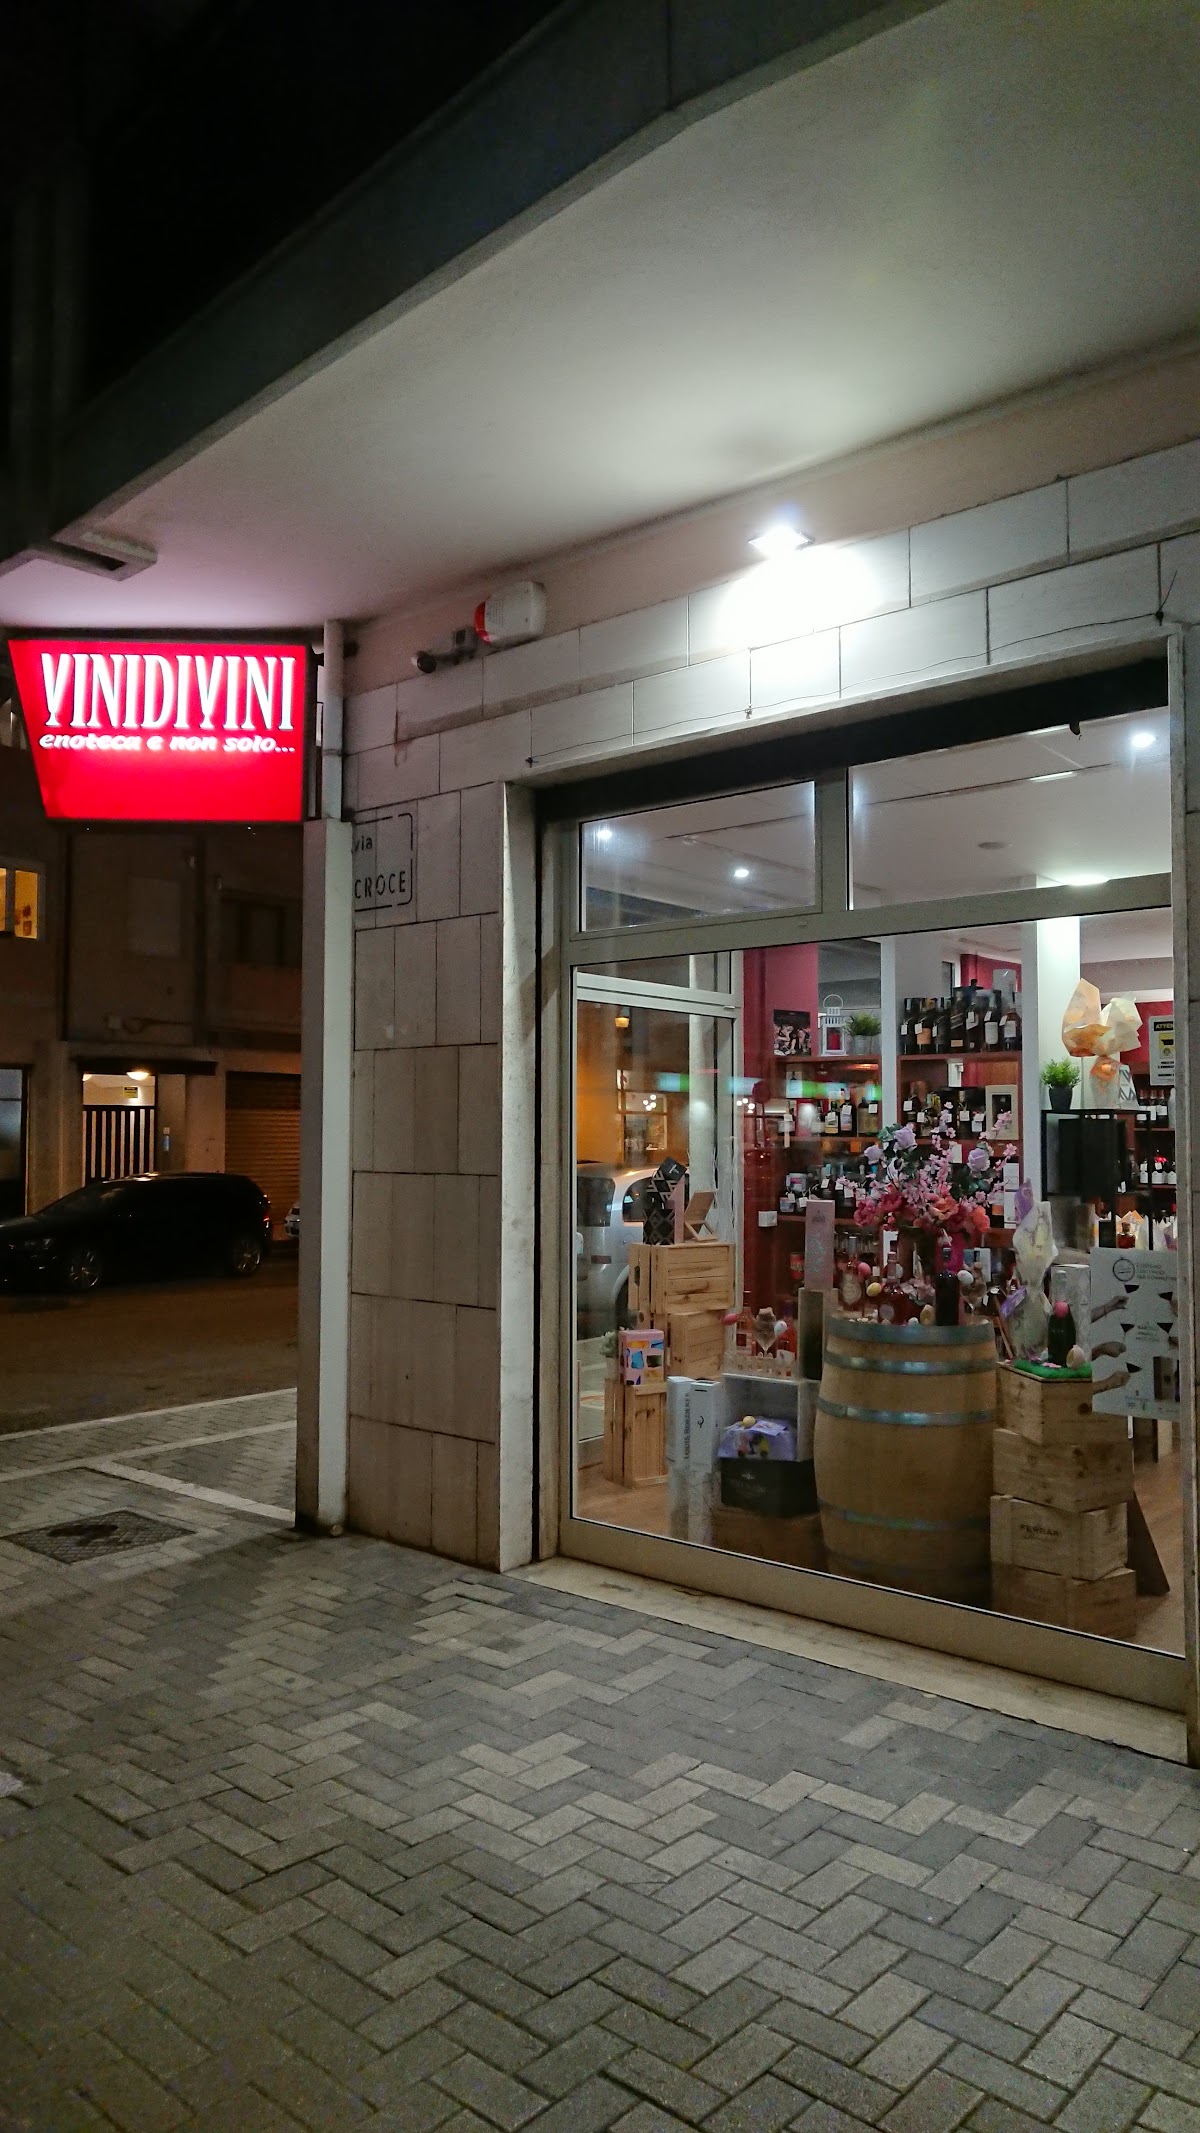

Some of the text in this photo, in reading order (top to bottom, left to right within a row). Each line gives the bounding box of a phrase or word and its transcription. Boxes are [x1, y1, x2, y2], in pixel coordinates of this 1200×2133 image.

[41, 653, 295, 730] VINIDIVINI
[39, 733, 295, 752] enoteca e non solo...
[354, 870, 406, 899] CROCE
